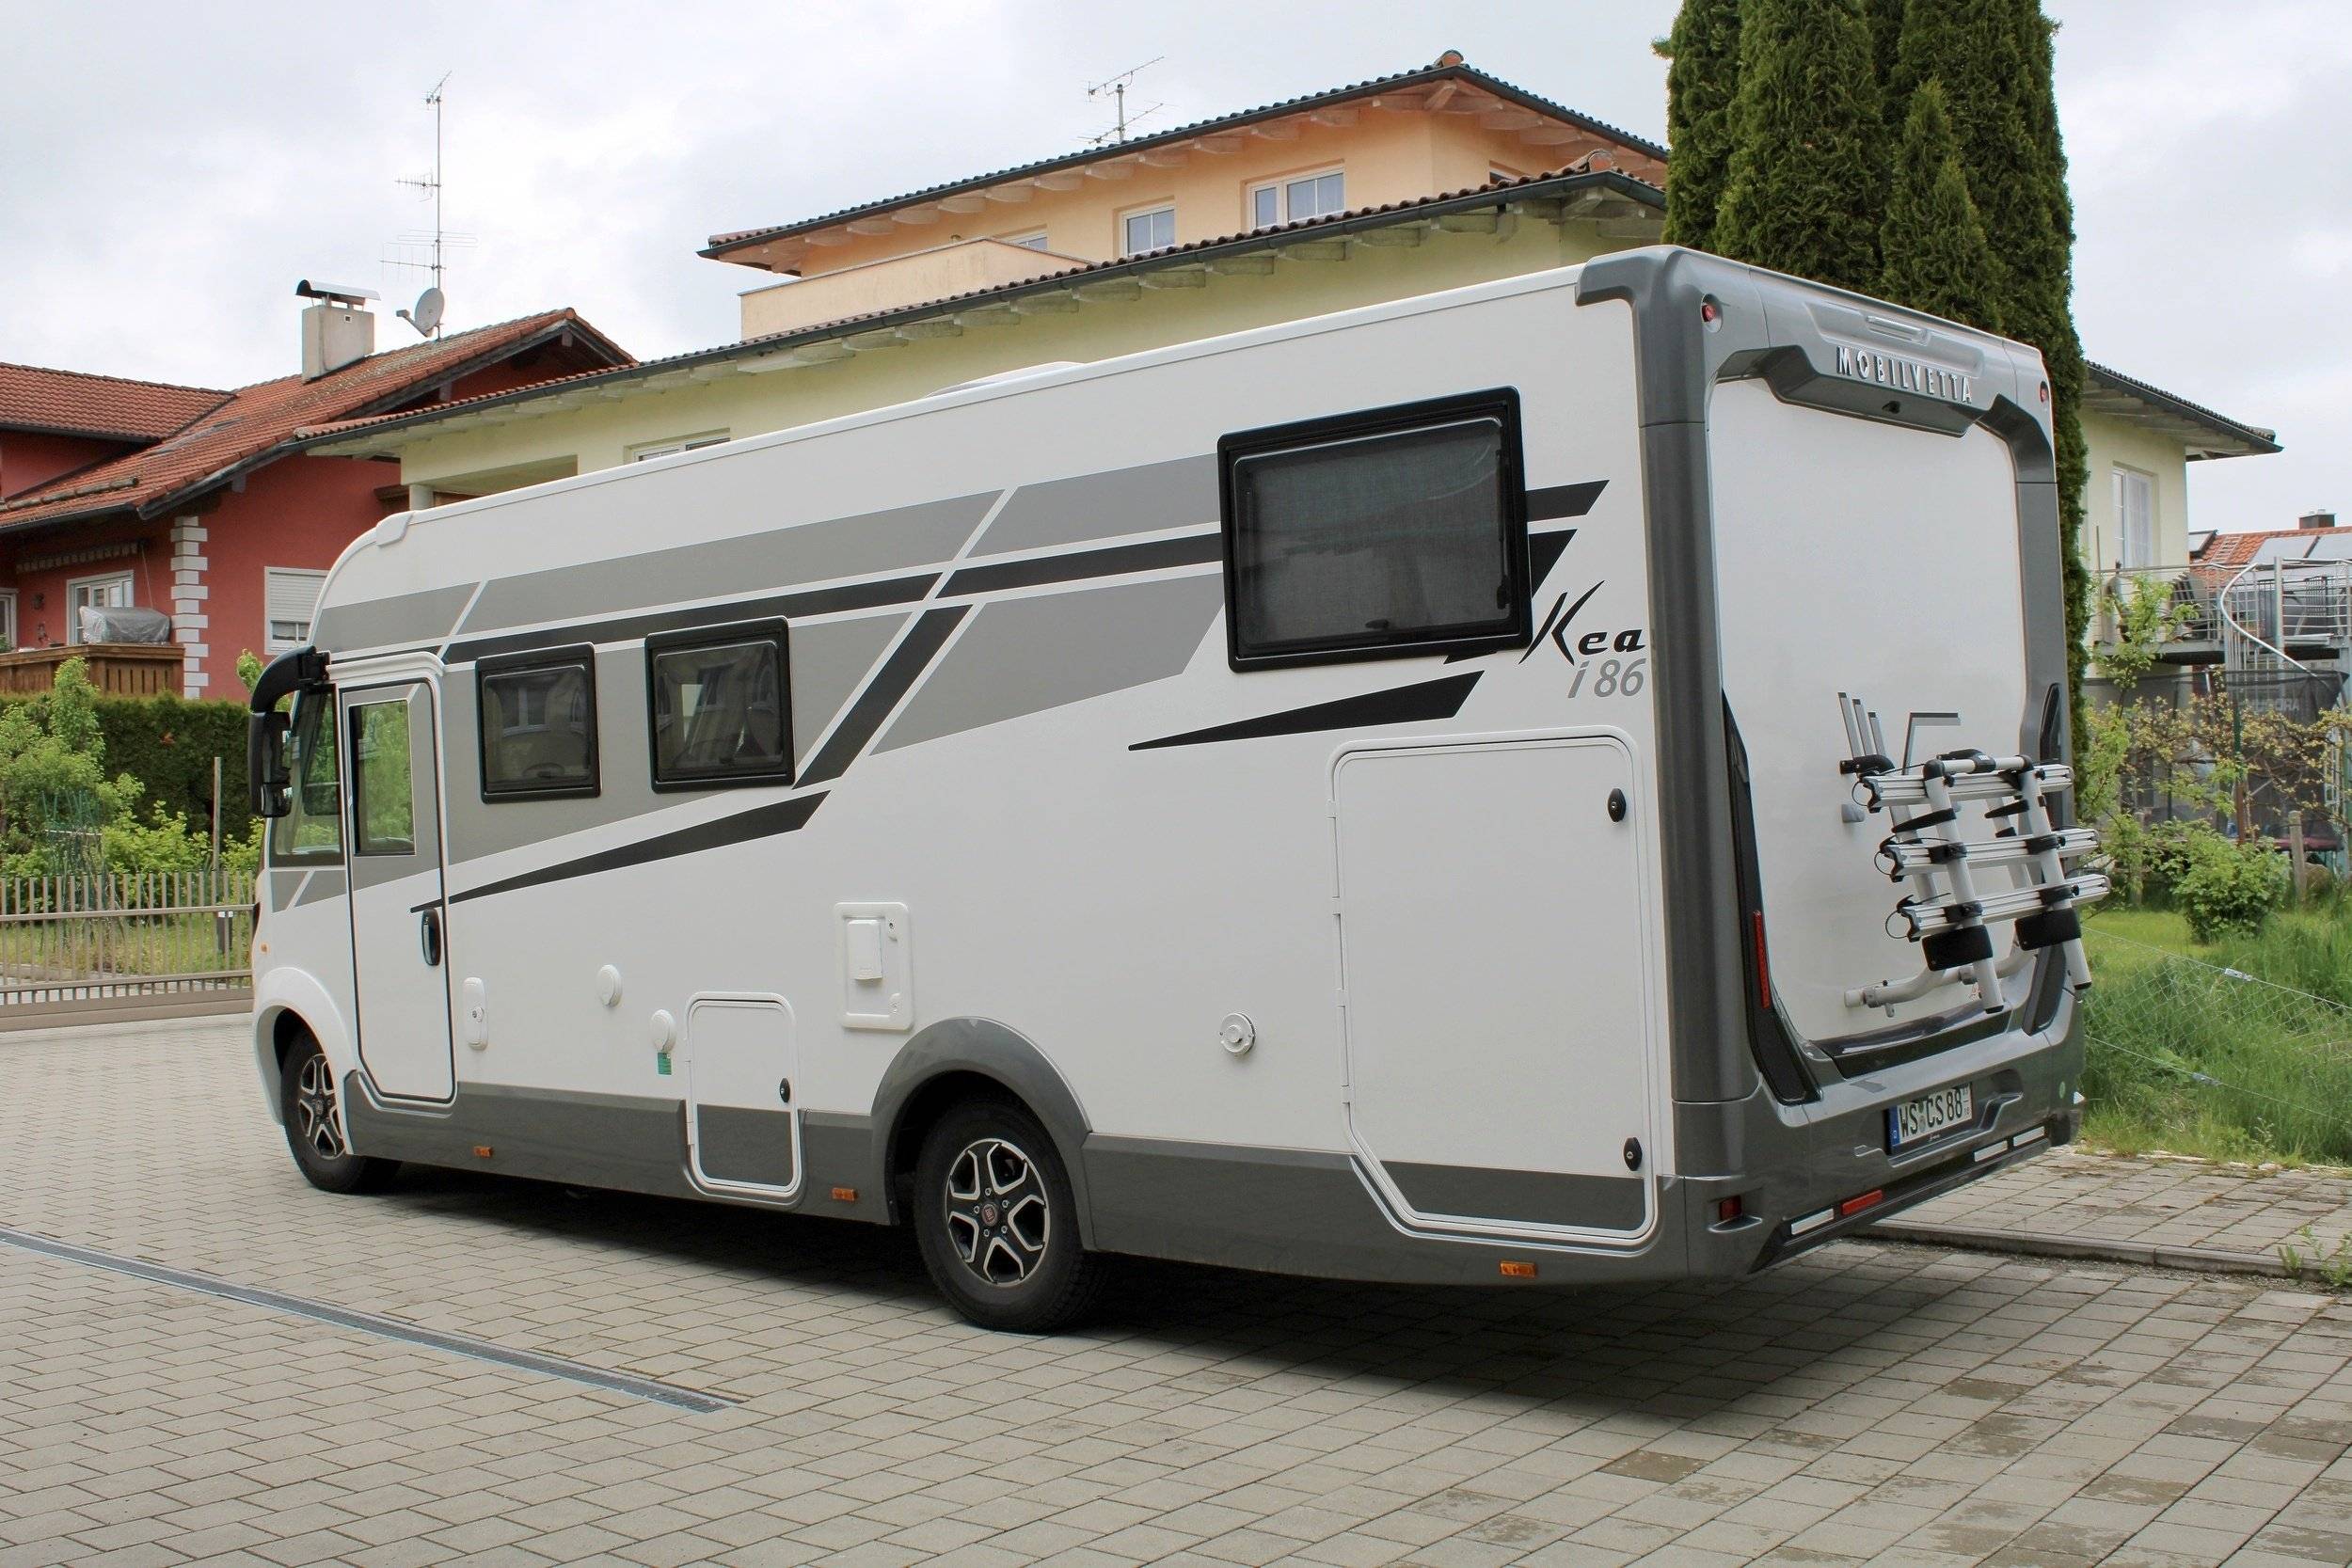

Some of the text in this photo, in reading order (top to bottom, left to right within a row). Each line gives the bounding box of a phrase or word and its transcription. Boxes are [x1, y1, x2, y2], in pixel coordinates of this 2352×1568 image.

[1836, 344, 1973, 404] MOBILVETTA
[1518, 579, 1646, 667] Kea
[1899, 1089, 1963, 1137] WS CS 88
